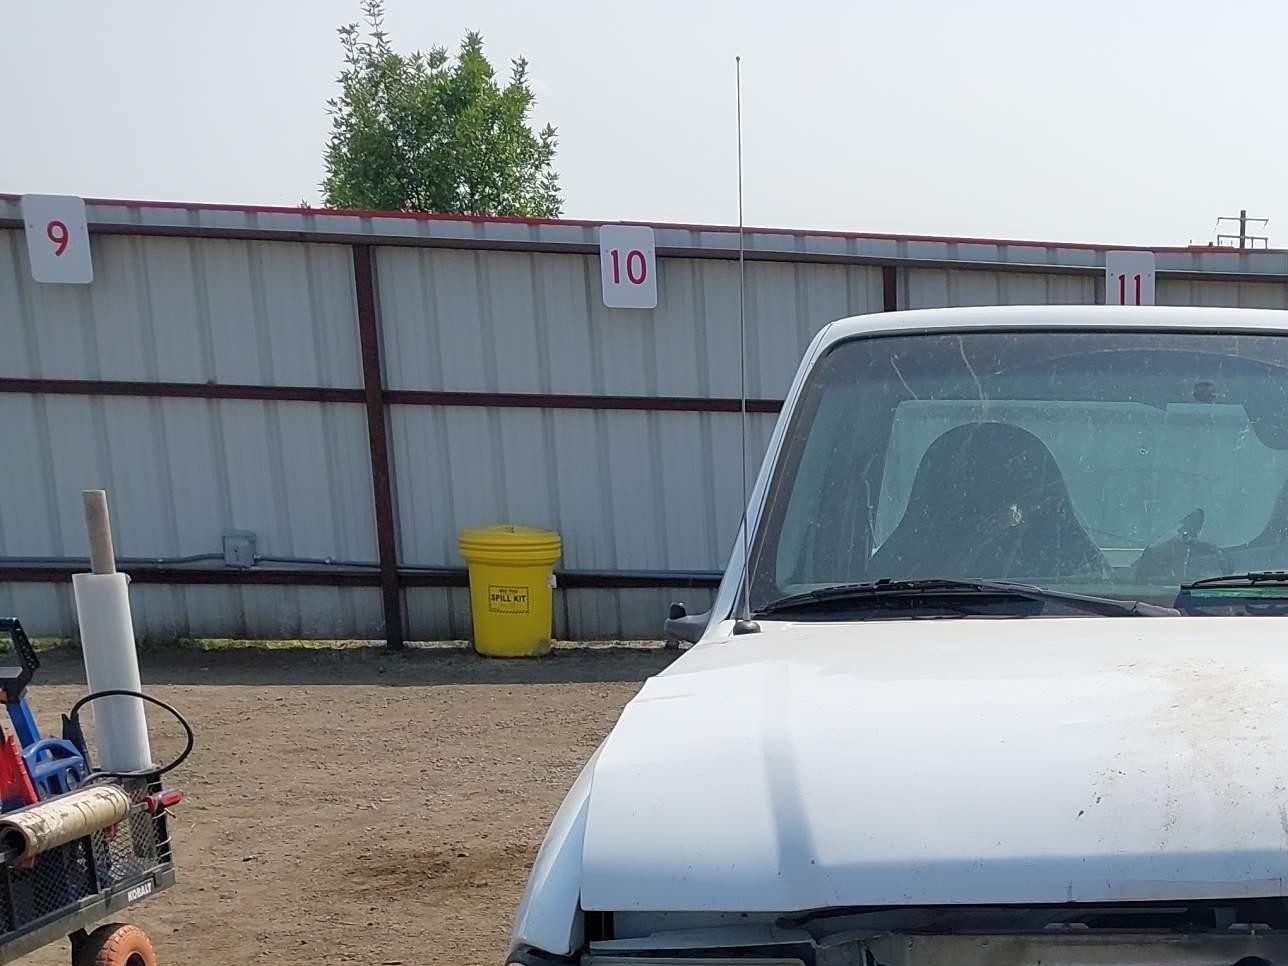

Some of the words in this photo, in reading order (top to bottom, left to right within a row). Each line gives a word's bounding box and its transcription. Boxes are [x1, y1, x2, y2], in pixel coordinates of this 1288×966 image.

[47, 220, 69, 257] 9
[610, 249, 647, 285] 10
[1118, 273, 1141, 306] 11
[491, 593, 512, 602] SPILL
